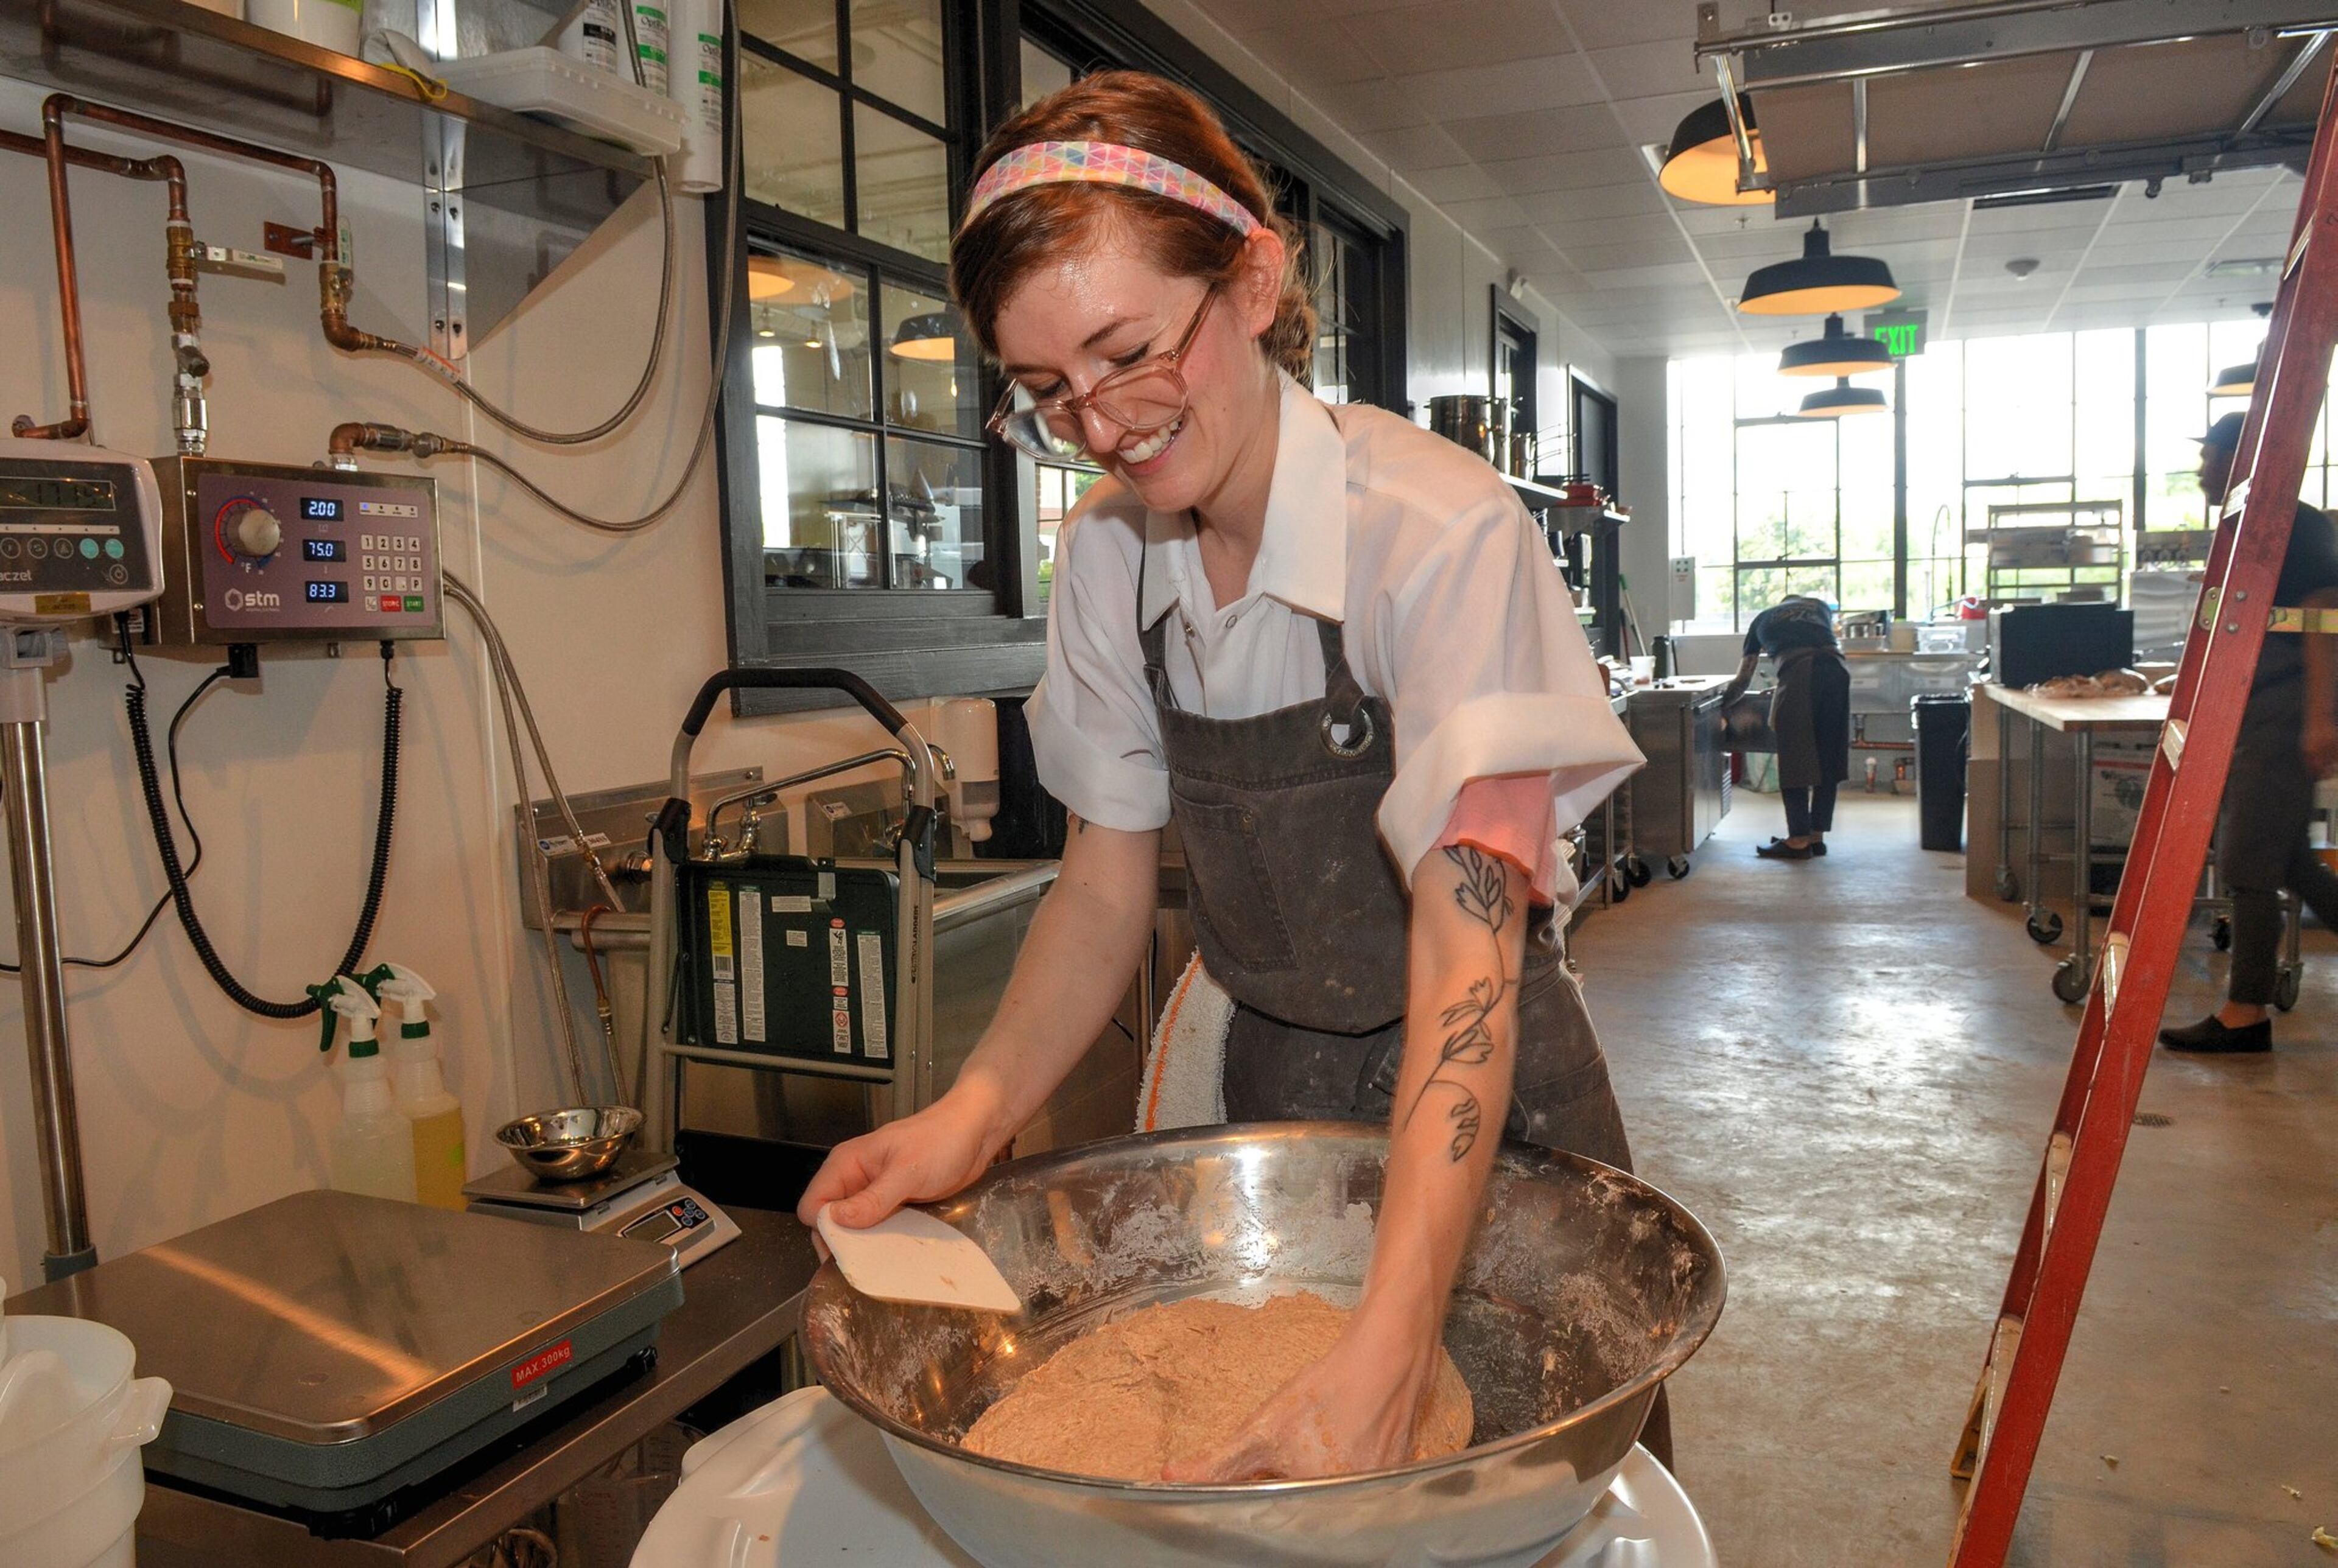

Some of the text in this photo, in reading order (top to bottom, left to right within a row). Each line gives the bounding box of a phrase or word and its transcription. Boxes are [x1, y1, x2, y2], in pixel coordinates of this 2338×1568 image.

[309, 501, 335, 516] 2.00
[309, 542, 333, 557] 75.0
[381, 539, 386, 548] 2
[396, 539, 401, 548] 3
[366, 559, 418, 569] 5 6 7 8
[309, 584, 336, 598] 83.3
[367, 579, 419, 589] 9 0 P
[245, 590, 280, 606] stm
